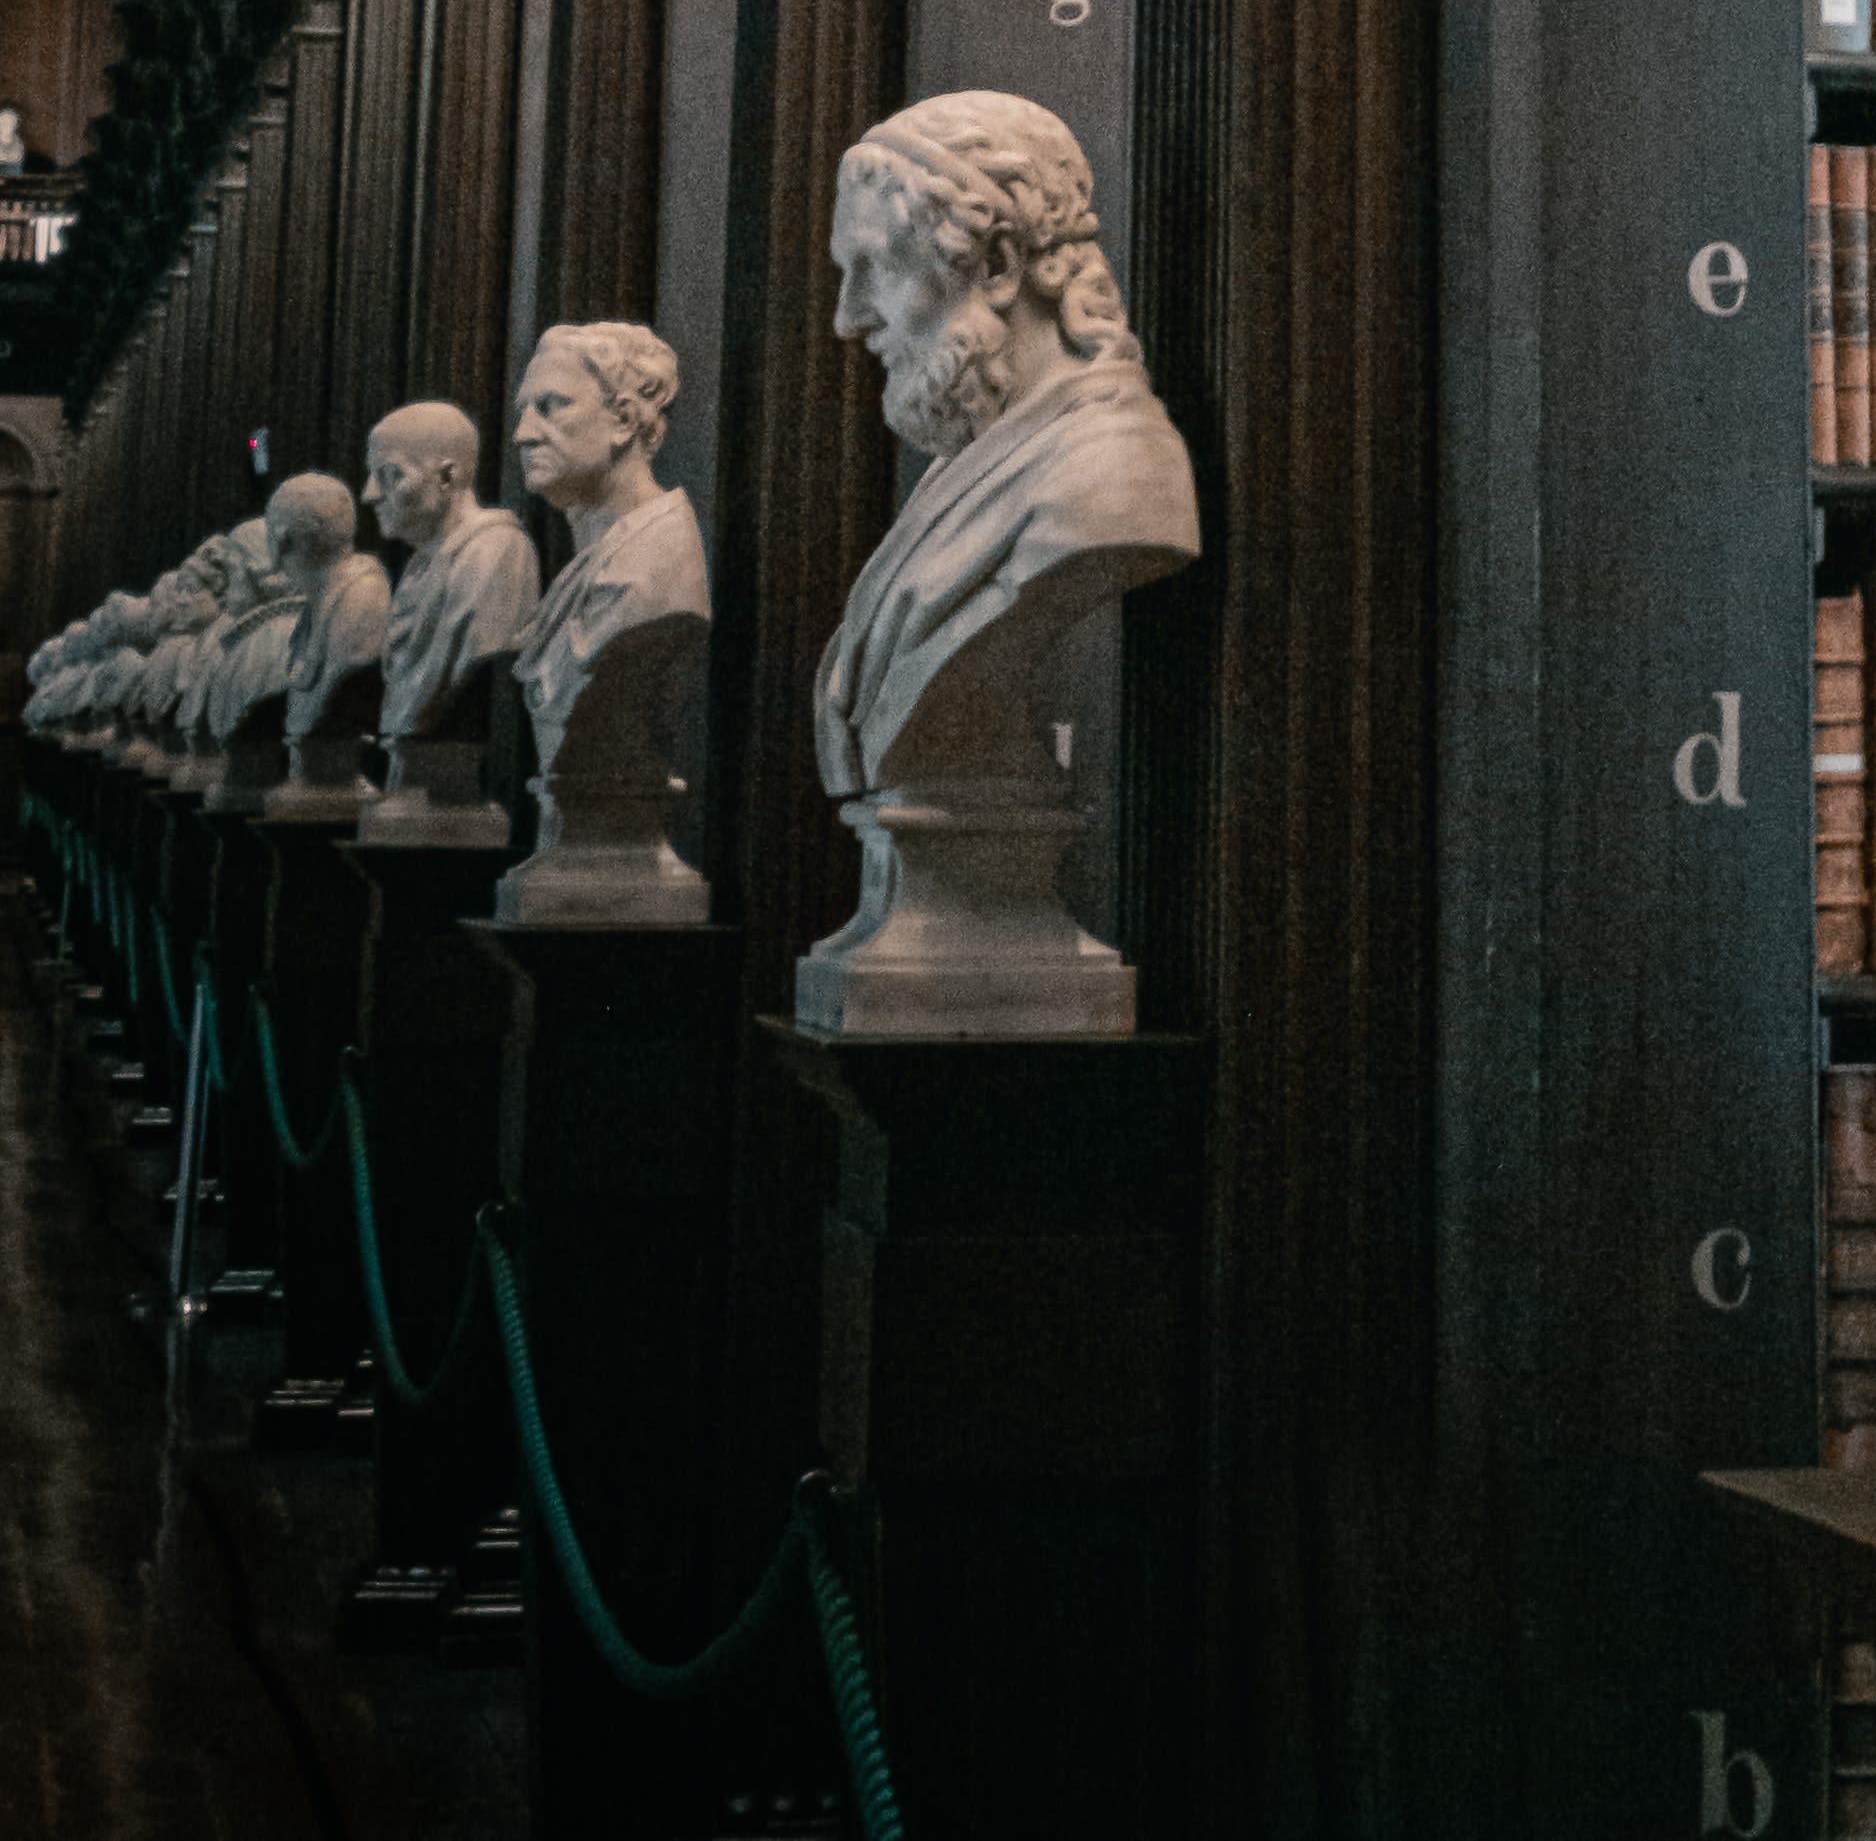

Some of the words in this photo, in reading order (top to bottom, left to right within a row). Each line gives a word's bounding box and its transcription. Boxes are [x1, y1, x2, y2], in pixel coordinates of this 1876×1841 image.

[1688, 241, 1749, 316] e
[1673, 691, 1746, 807] d
[1691, 1227, 1752, 1310] c
[1689, 1711, 1775, 1841] b
